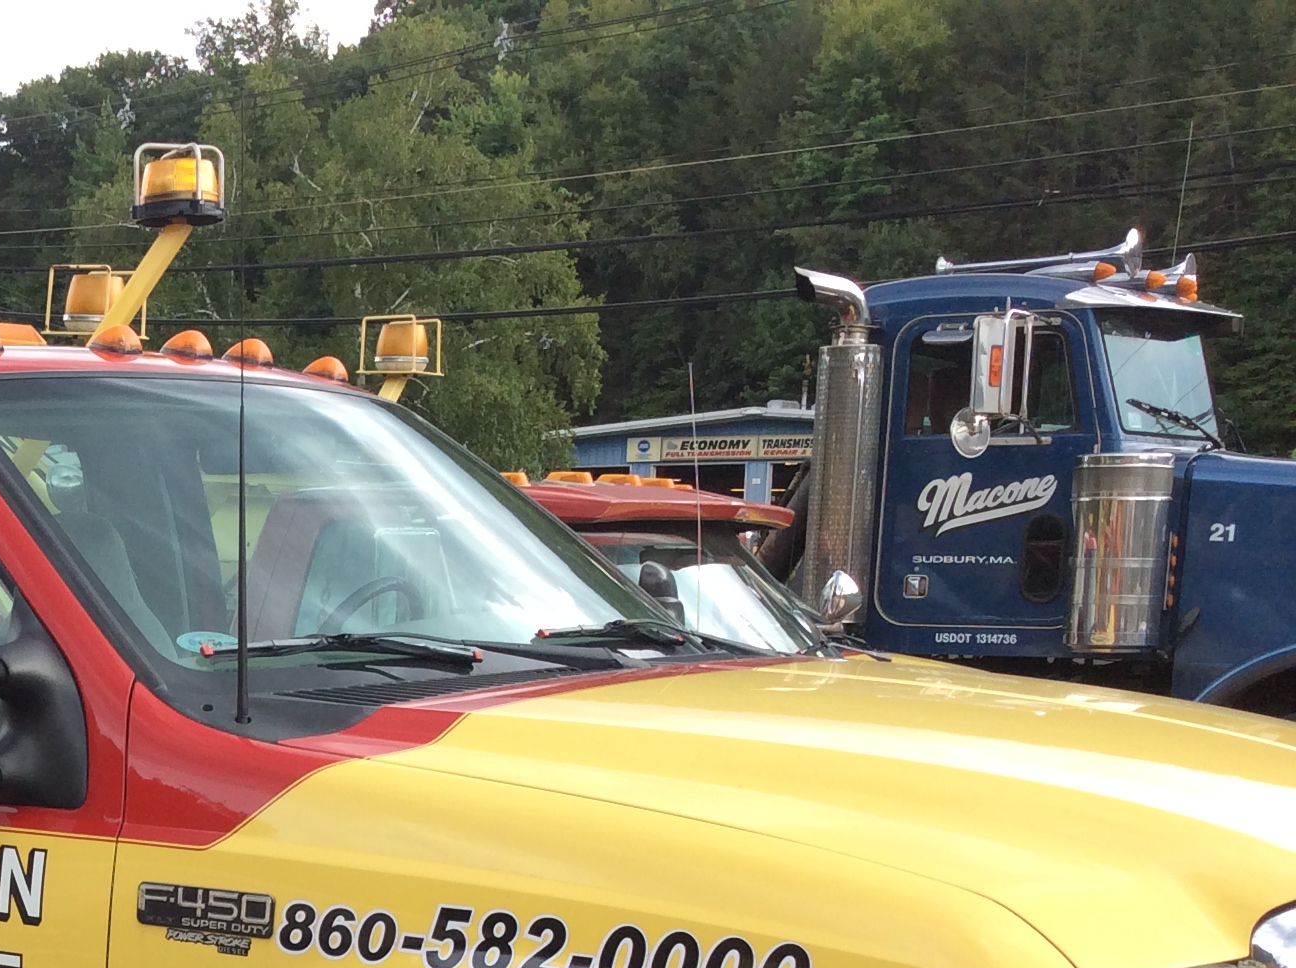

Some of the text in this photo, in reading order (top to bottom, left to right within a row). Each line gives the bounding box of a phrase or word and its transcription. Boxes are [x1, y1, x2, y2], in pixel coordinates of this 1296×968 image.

[680, 439, 752, 451] ECONOMY
[687, 449, 752, 458] TRANSMISSION
[917, 471, 1058, 537] Macone
[1209, 523, 1236, 542] 21
[935, 632, 1018, 644] USDOT 1314736
[181, 917, 270, 936] SUPER DUTY
[167, 929, 251, 949] POWER STROKE
[218, 945, 247, 956] DIESEL
